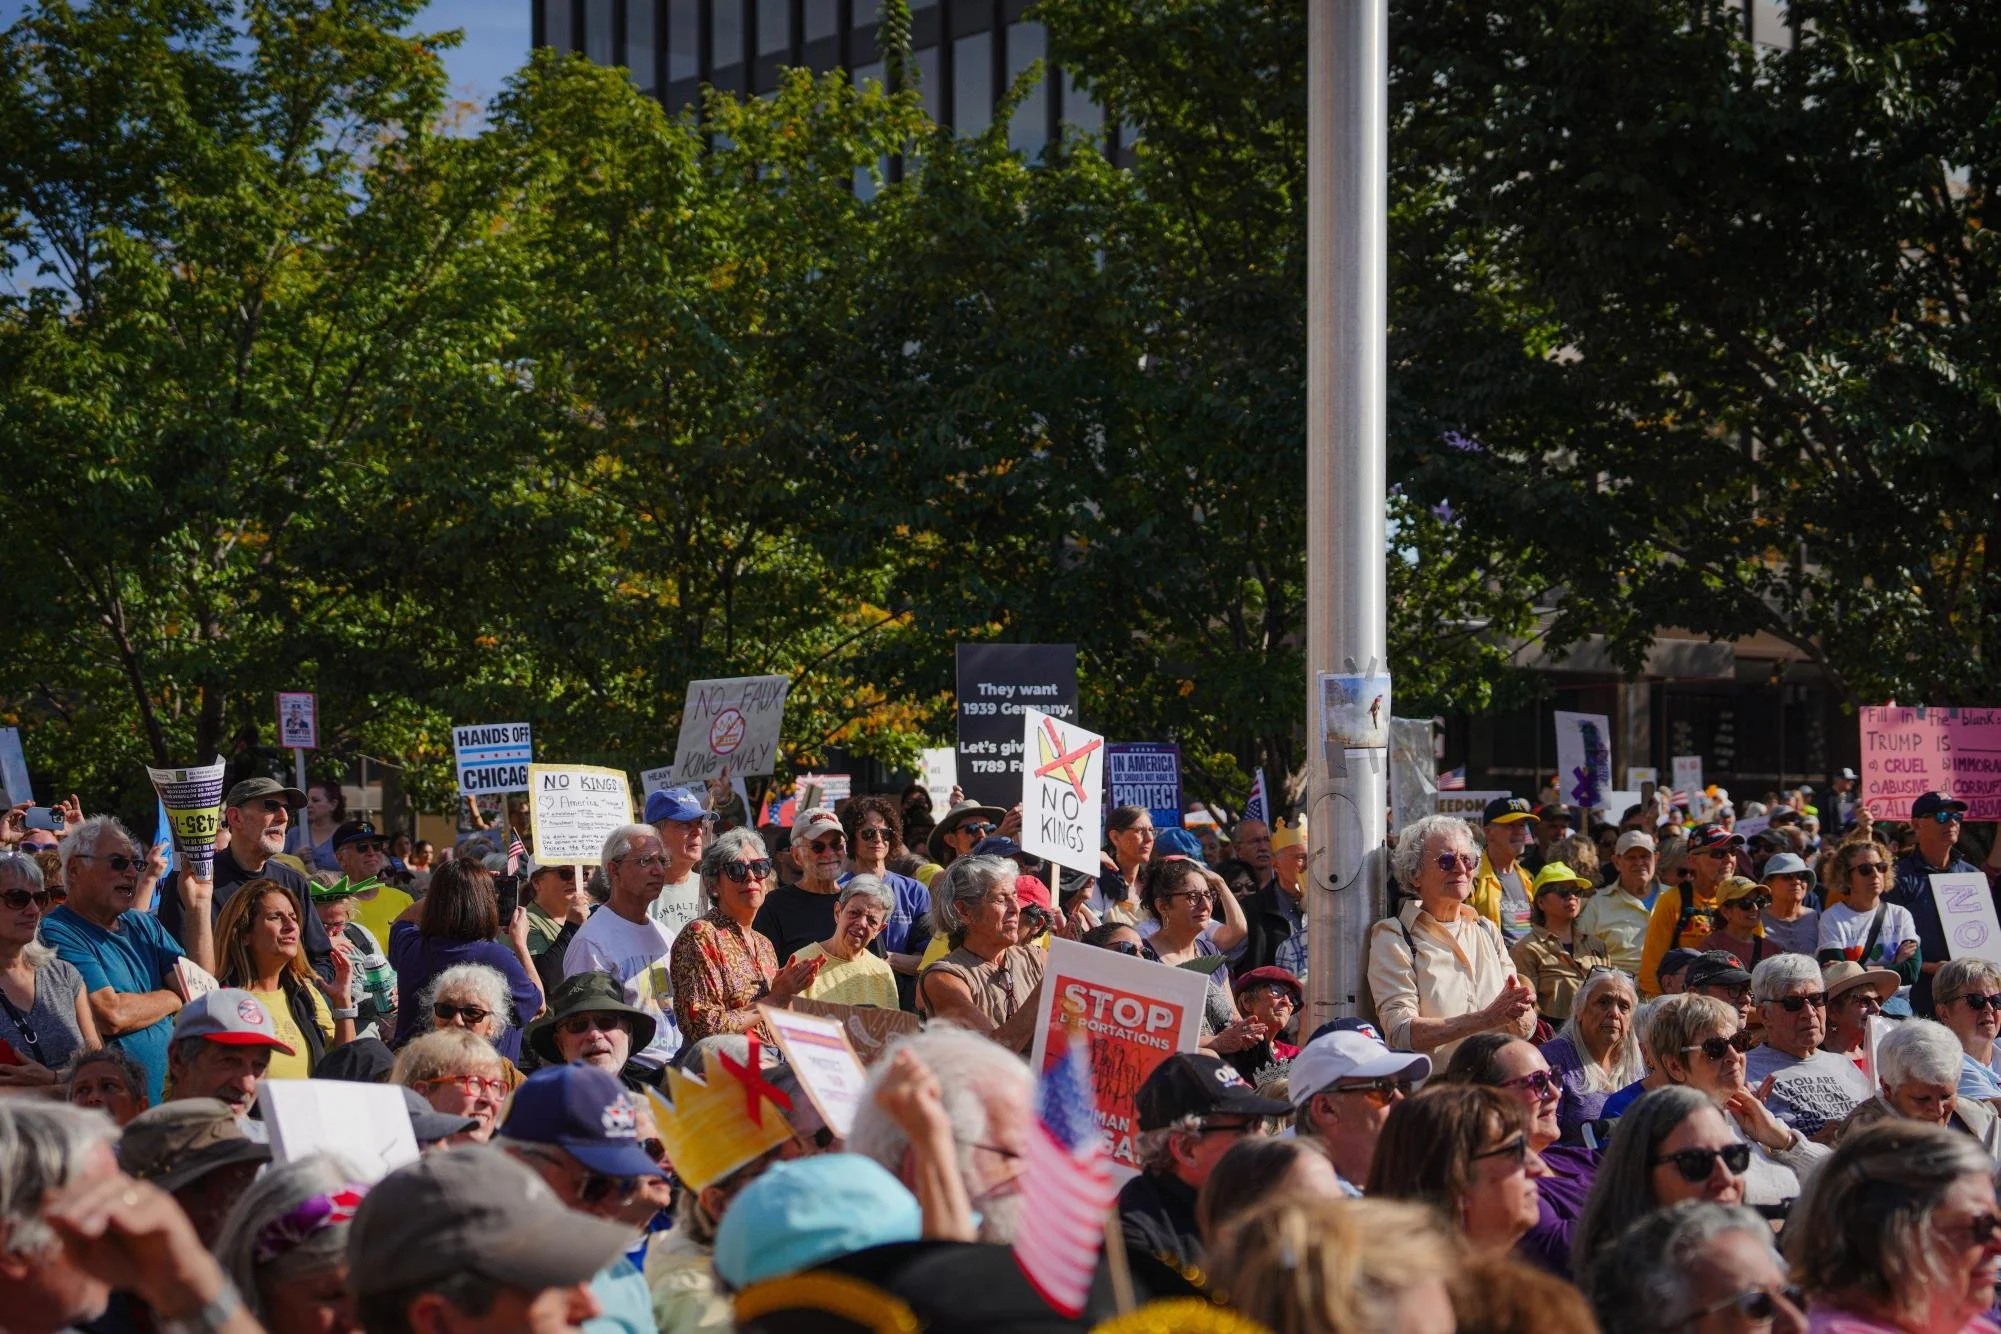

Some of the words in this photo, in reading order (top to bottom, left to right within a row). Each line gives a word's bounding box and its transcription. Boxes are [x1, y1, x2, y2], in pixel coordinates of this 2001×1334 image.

[977, 683, 1015, 698] They
[1020, 685, 1058, 696] want
[694, 687, 725, 720] NO
[740, 682, 784, 715] FAUX
[963, 702, 997, 715] 1939
[1001, 702, 1073, 718] Gerany.
[1867, 707, 1887, 723] Fill
[1900, 709, 1914, 723] in
[1927, 709, 1951, 726] the
[458, 728, 509, 747] HANDS
[513, 727, 529, 742] OFF
[1867, 731, 1922, 751] TRUMP
[1936, 735, 1951, 752] IS
[1000, 739, 1025, 756] giv
[681, 752, 718, 778] KING
[729, 743, 770, 773] WAY
[971, 760, 1007, 774] 1789
[1113, 755, 1125, 772] IN
[1128, 755, 1174, 772] AMERICA
[1884, 758, 1928, 773] CRUEL
[464, 766, 528, 790] CHICAG
[544, 775, 570, 790] NO
[580, 776, 617, 791] KINGS
[648, 769, 672, 782] HEAVY
[1042, 782, 1079, 821] NO
[1112, 784, 1178, 809] PROTECT
[1041, 813, 1084, 853] KINGS
[1062, 983, 1174, 1034] STOP
[1772, 1081, 1788, 1092] IF
[1785, 1077, 1813, 1088] YOU
[1816, 1076, 1837, 1085] ARE
